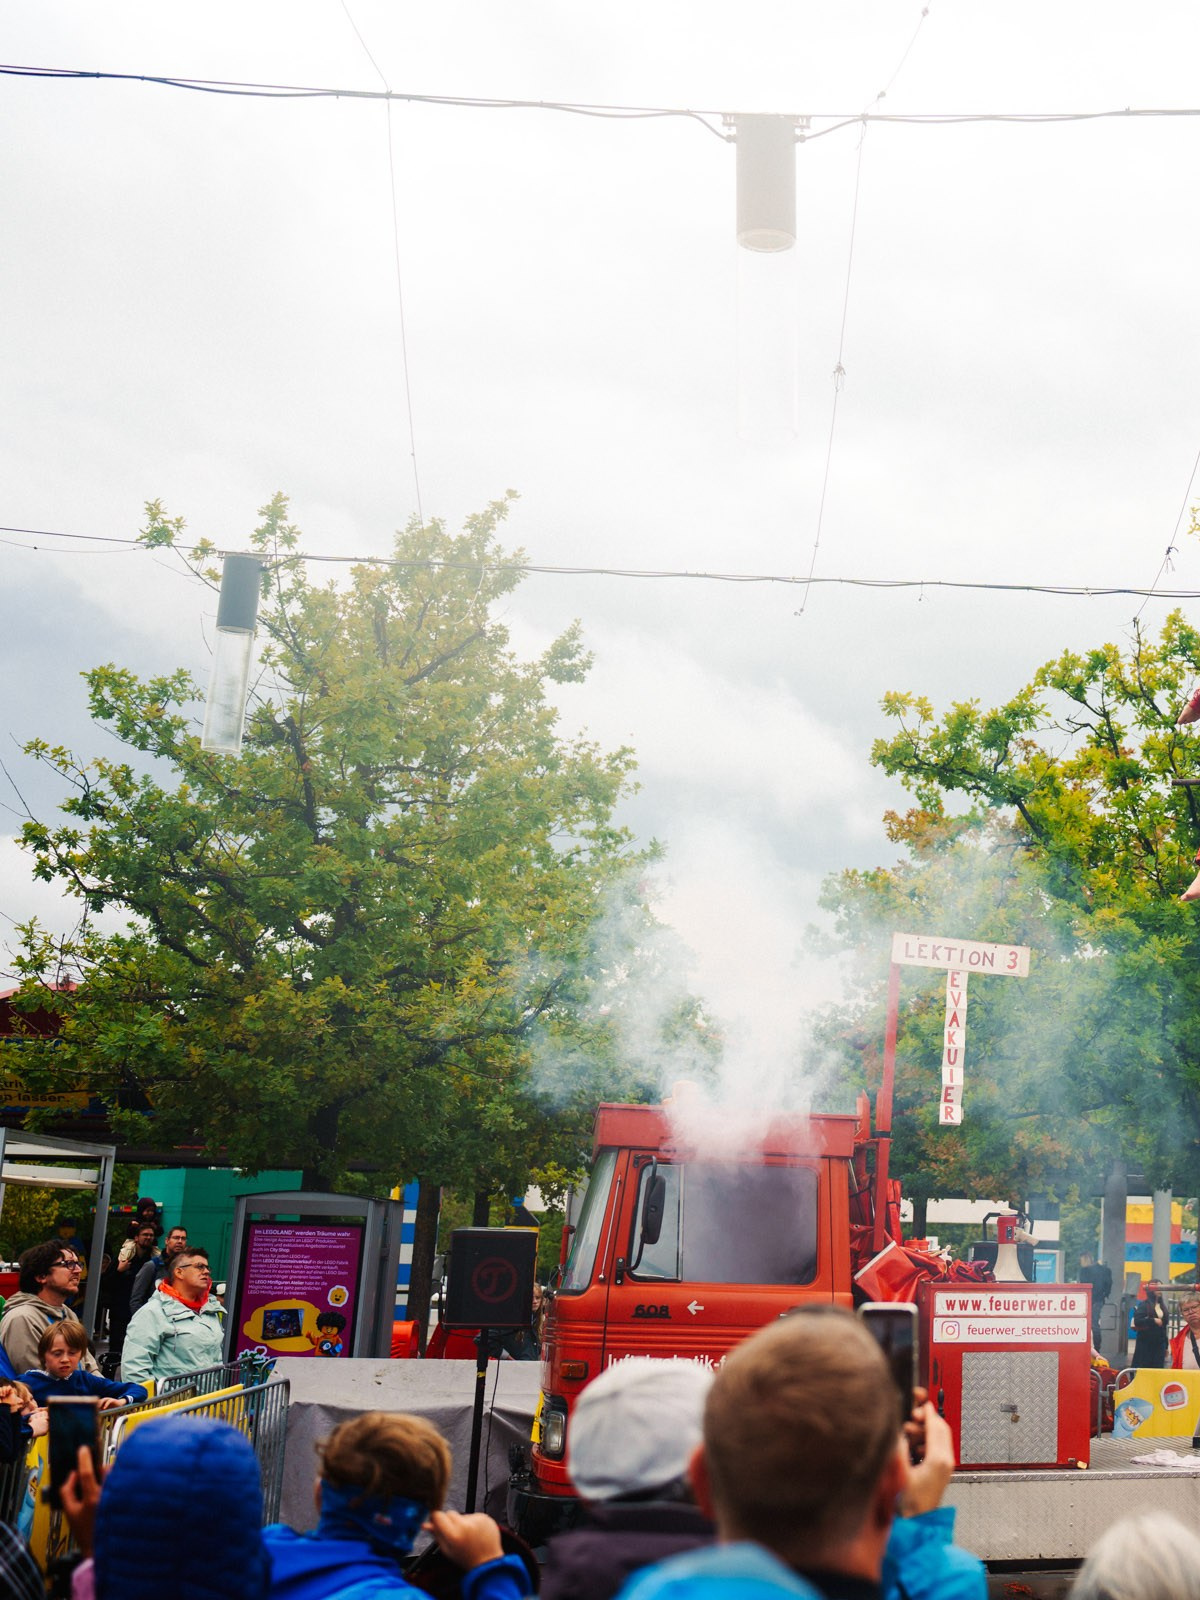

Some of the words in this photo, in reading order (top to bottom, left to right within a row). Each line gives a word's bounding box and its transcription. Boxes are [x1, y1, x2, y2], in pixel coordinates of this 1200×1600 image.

[904, 942, 994, 967] LEKTION
[1006, 951, 1018, 970] 3
[944, 972, 962, 1120] EVAKUIER
[634, 1304, 670, 1316] 608
[946, 1296, 1076, 1311] www.feuerwer.de
[968, 1324, 1080, 1336] feuerwer_streetshow
